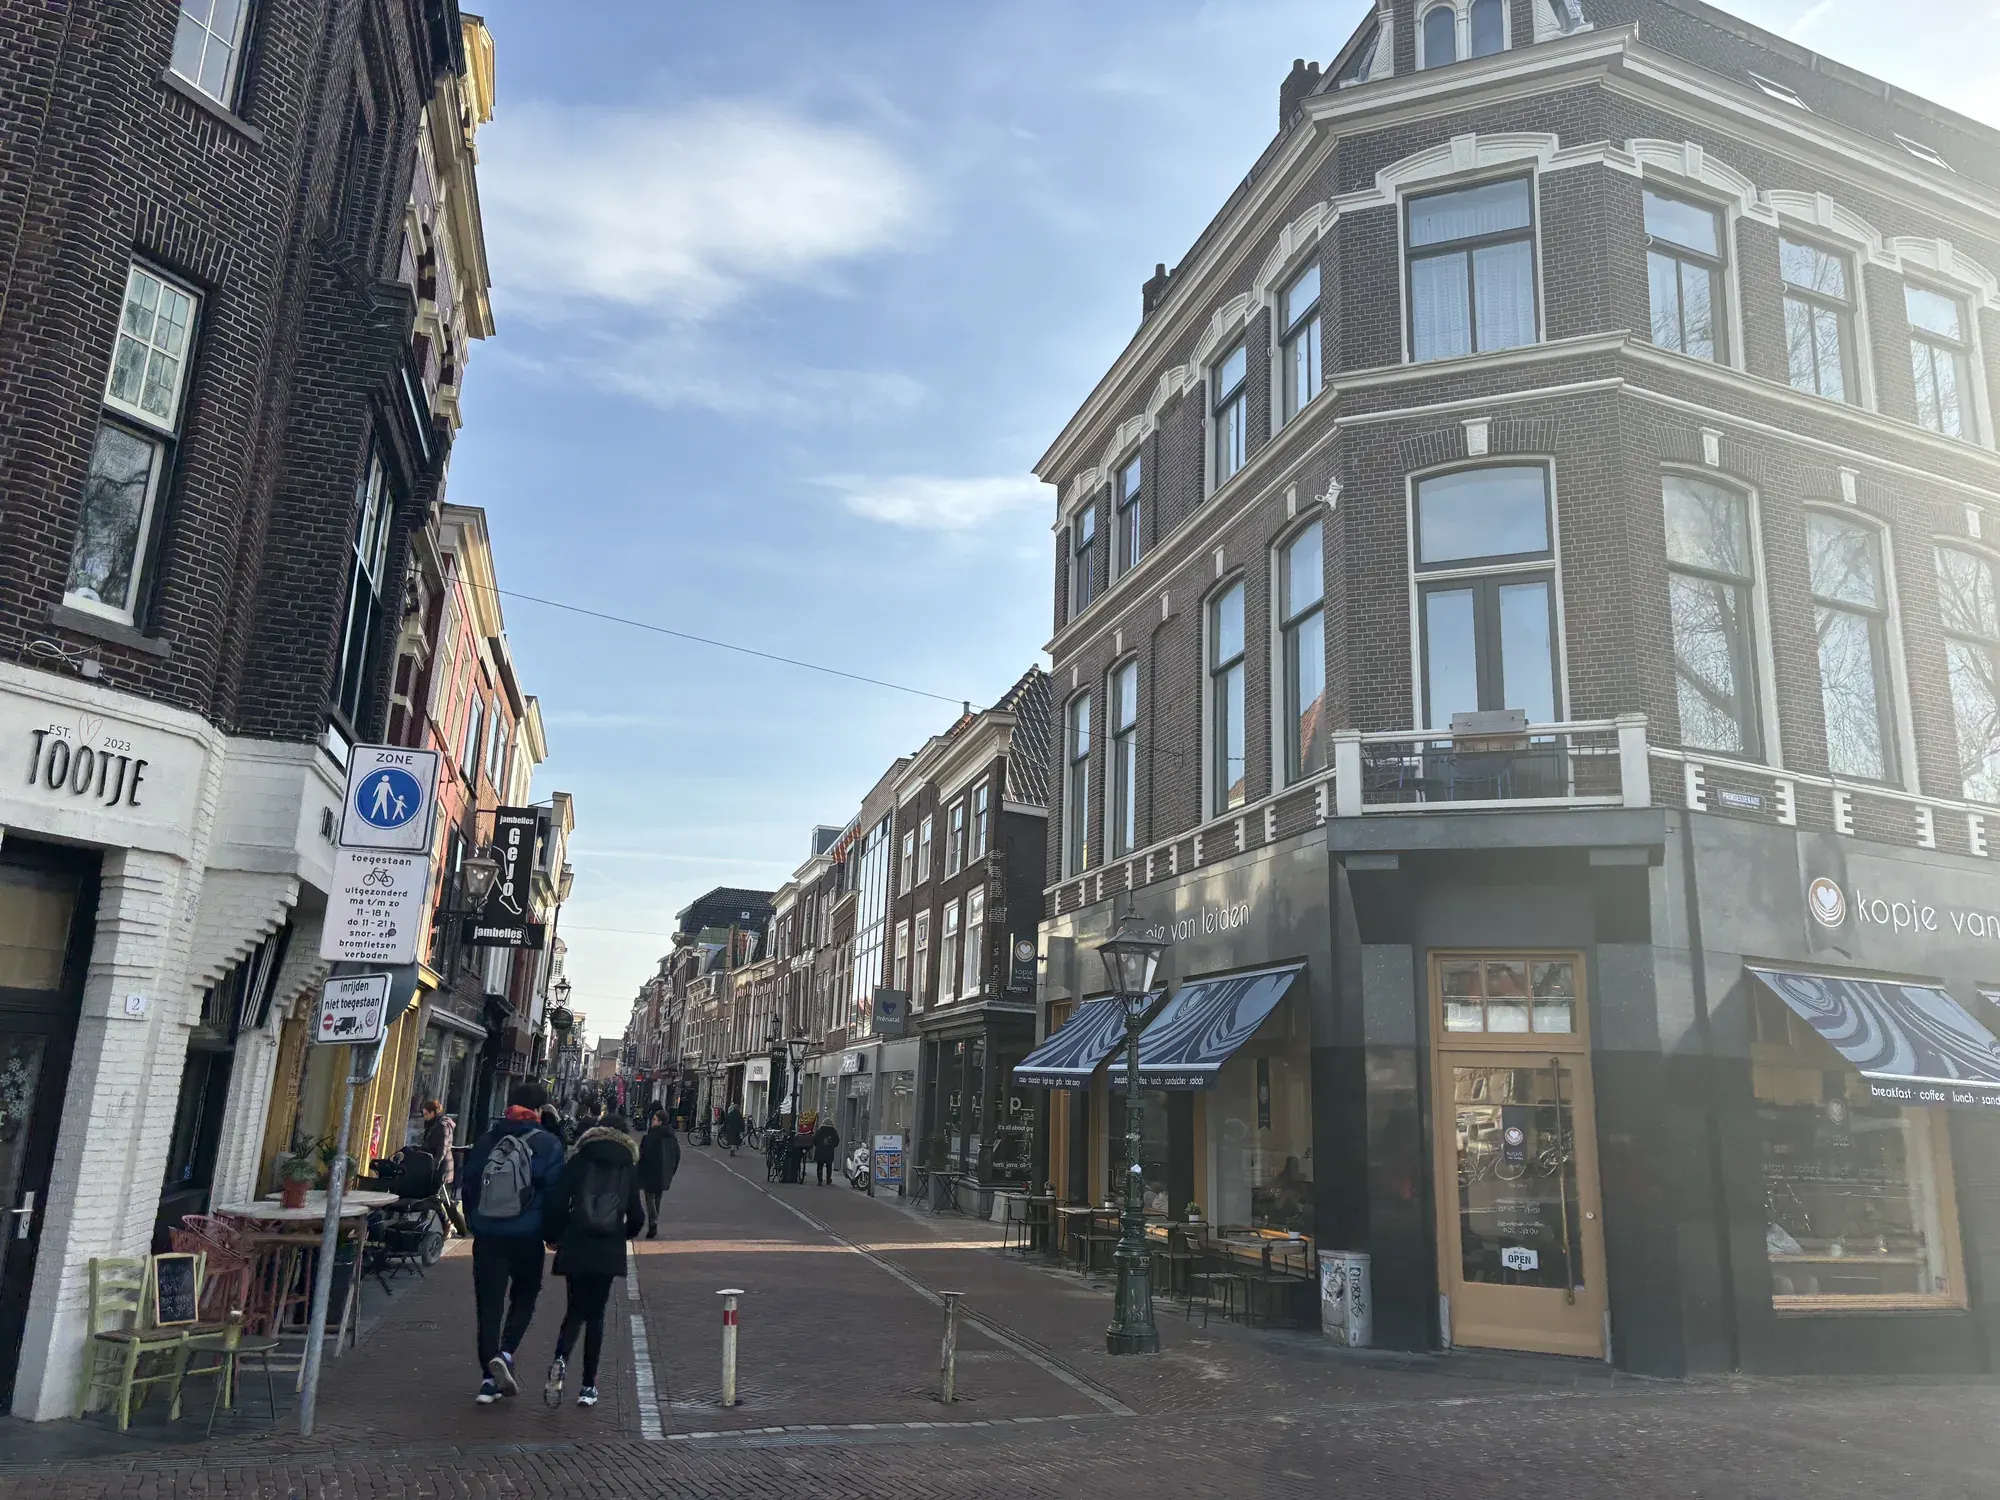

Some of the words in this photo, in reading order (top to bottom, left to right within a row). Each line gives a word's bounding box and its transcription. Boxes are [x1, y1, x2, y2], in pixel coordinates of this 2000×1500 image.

[48, 724, 71, 739] EST.
[104, 738, 131, 752] 2023
[376, 753, 414, 765] ZONE
[29, 729, 149, 806] TOOTJE
[499, 815, 534, 825] jambelles
[351, 854, 412, 866] toegestaan
[345, 887, 408, 898] uitgezonderd
[367, 898, 386, 907] t/m
[1170, 918, 1197, 942] van
[1202, 898, 1250, 935] leiden
[1856, 889, 1938, 934] kopje
[1949, 911, 2000, 939] van
[347, 918, 358, 926] do
[390, 920, 396, 928] h
[473, 925, 523, 940] jambelles
[339, 939, 397, 949] bromfietsen
[344, 951, 389, 960] verboden
[340, 980, 369, 995] inrijden
[131, 997, 141, 1011] 2
[324, 998, 340, 1010] niet
[340, 997, 380, 1011] toegestaan
[1871, 1084, 1912, 1099] breakfast
[1920, 1089, 1945, 1101] coffee
[1952, 1090, 1974, 1104] lunch
[1508, 1254, 1532, 1265] OPEN
